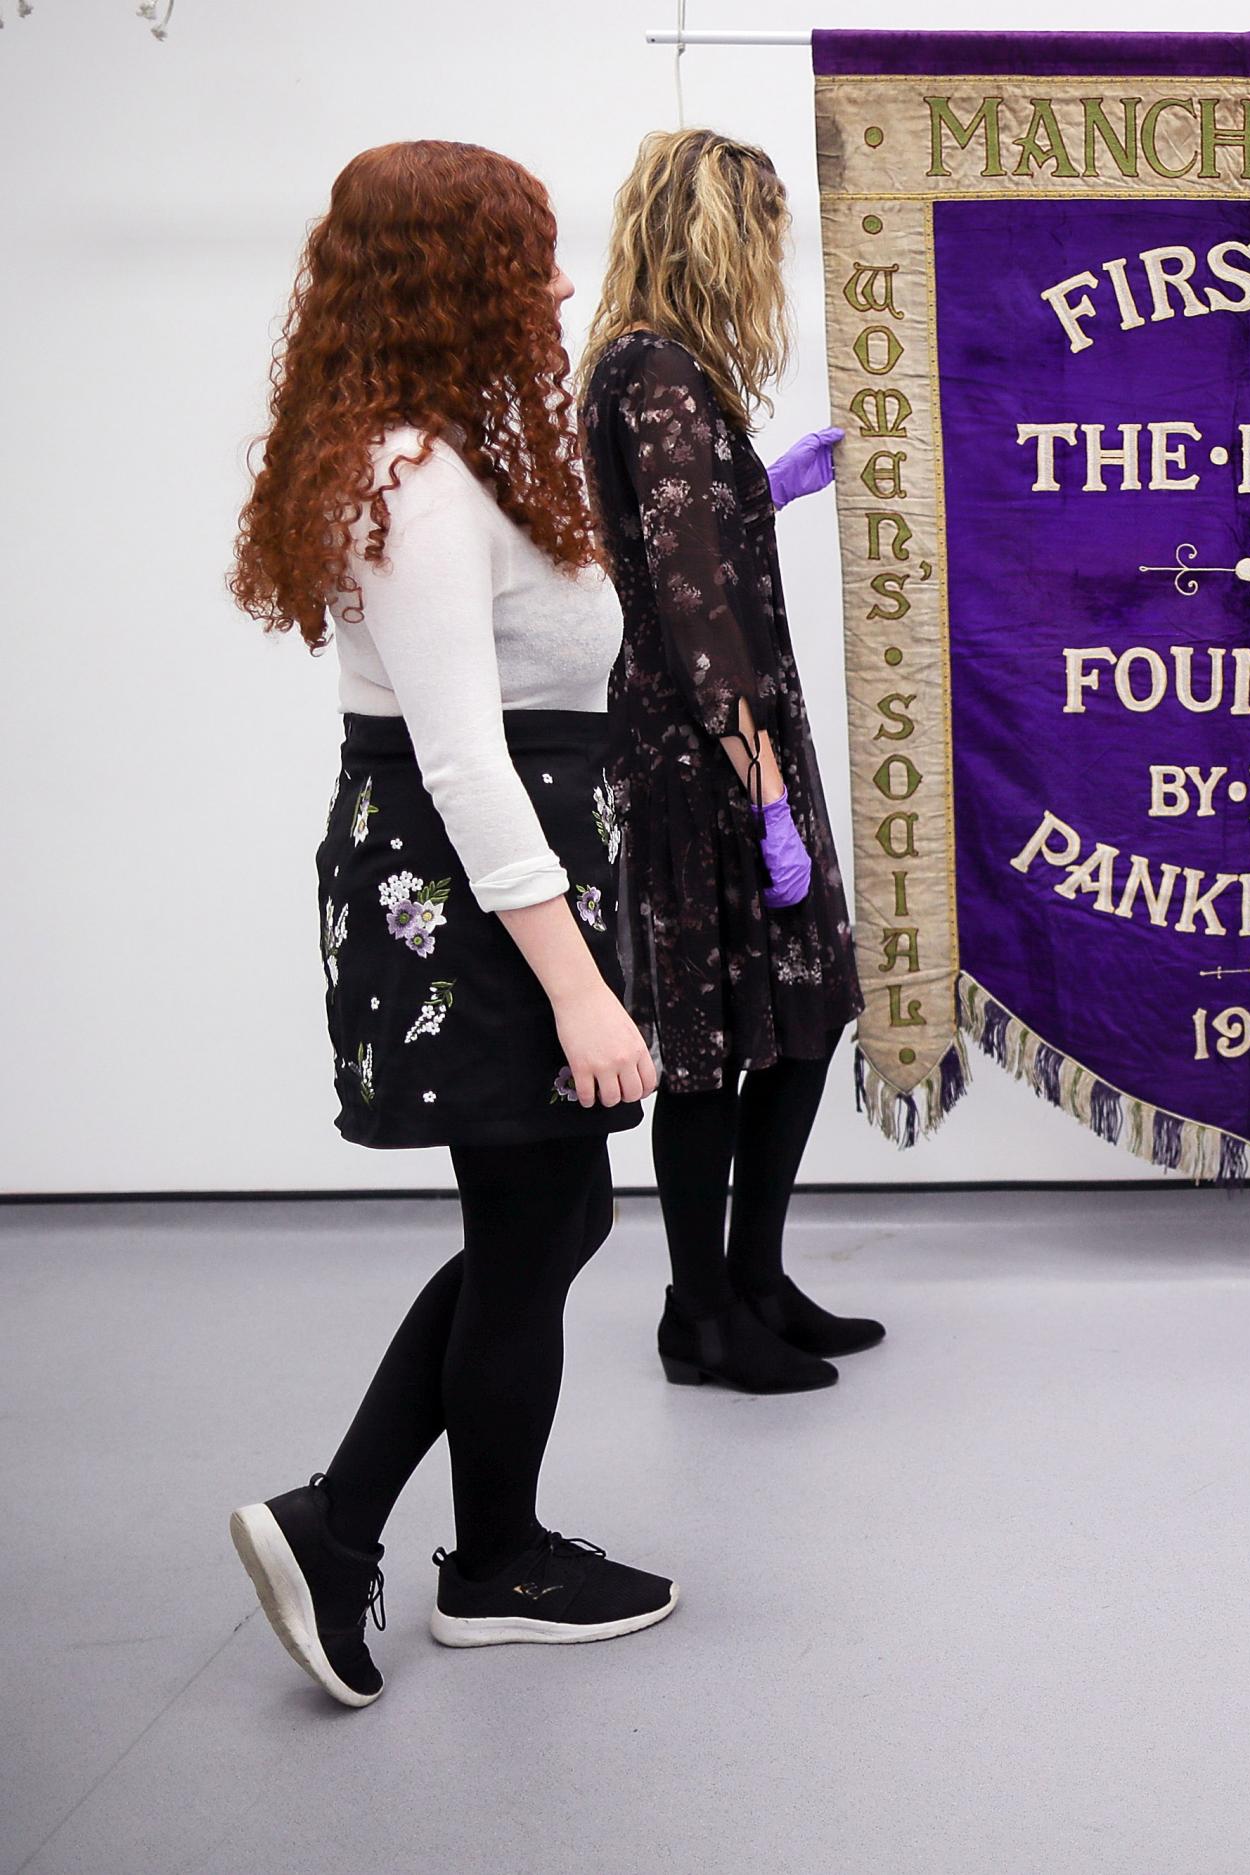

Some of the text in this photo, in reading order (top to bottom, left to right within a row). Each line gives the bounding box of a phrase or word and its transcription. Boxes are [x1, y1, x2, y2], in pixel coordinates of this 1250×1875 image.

[1016, 421, 1203, 492] THE
[1148, 764, 1228, 818] BY
[872, 692, 927, 1027] SOCIAL
